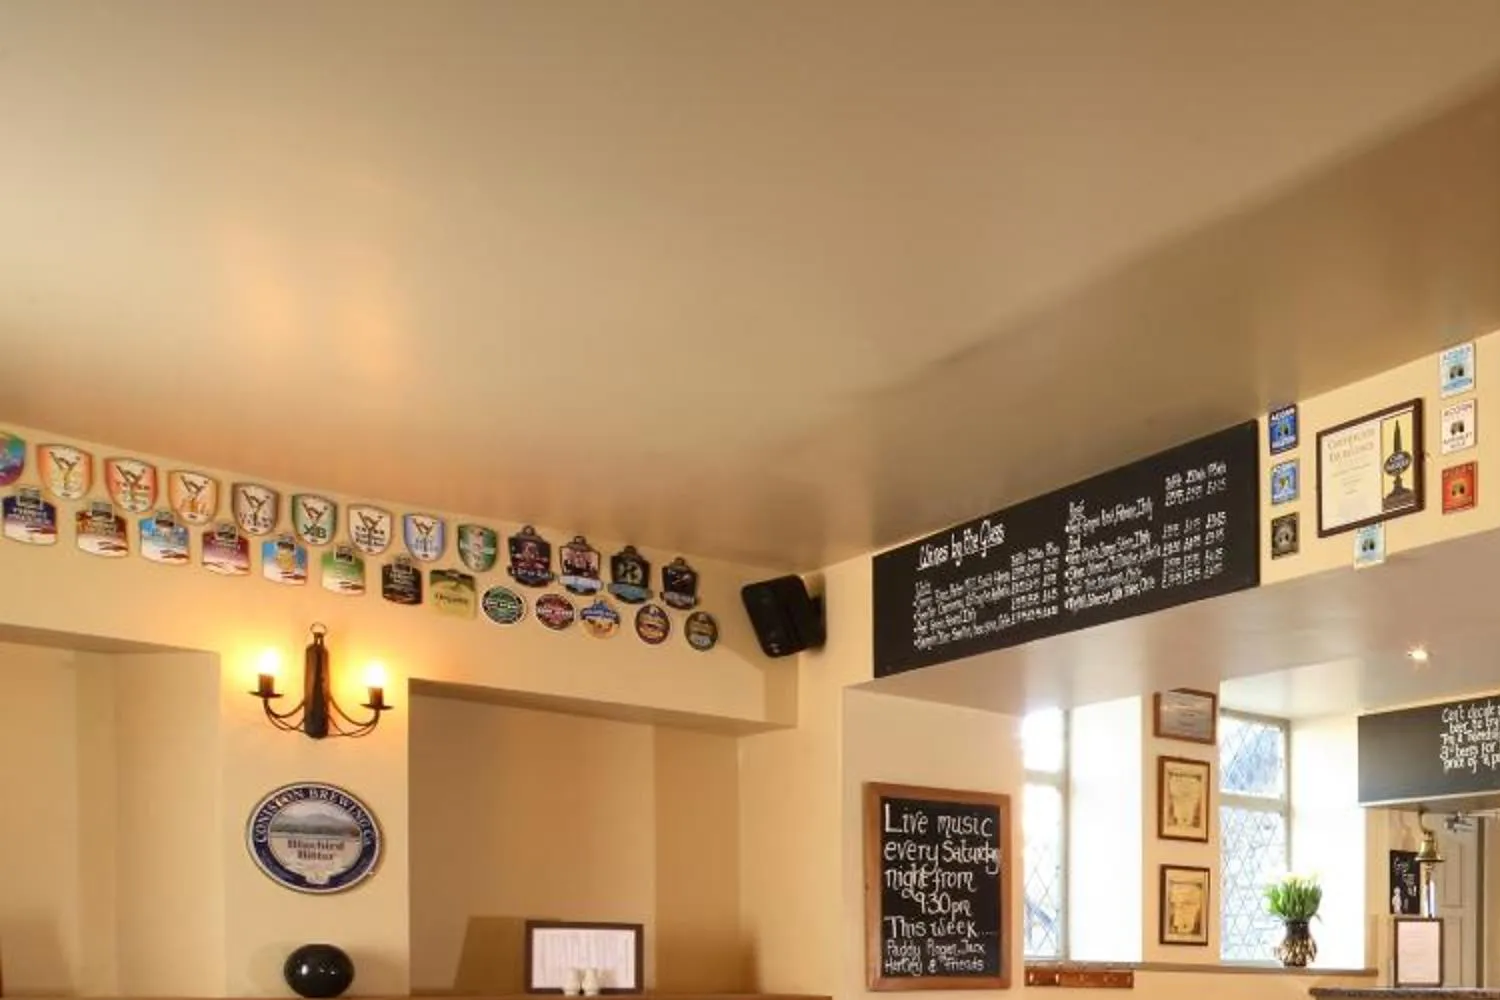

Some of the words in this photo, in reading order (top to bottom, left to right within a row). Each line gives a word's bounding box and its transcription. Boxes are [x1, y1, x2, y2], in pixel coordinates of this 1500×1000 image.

[884, 803, 929, 835] Live
[937, 814, 993, 838] music
[884, 839, 939, 875] every
[942, 838, 1001, 875] Saturday
[885, 863, 930, 899] night
[932, 868, 978, 893] from
[884, 915, 928, 939] This
[887, 939, 922, 961] Paddy
